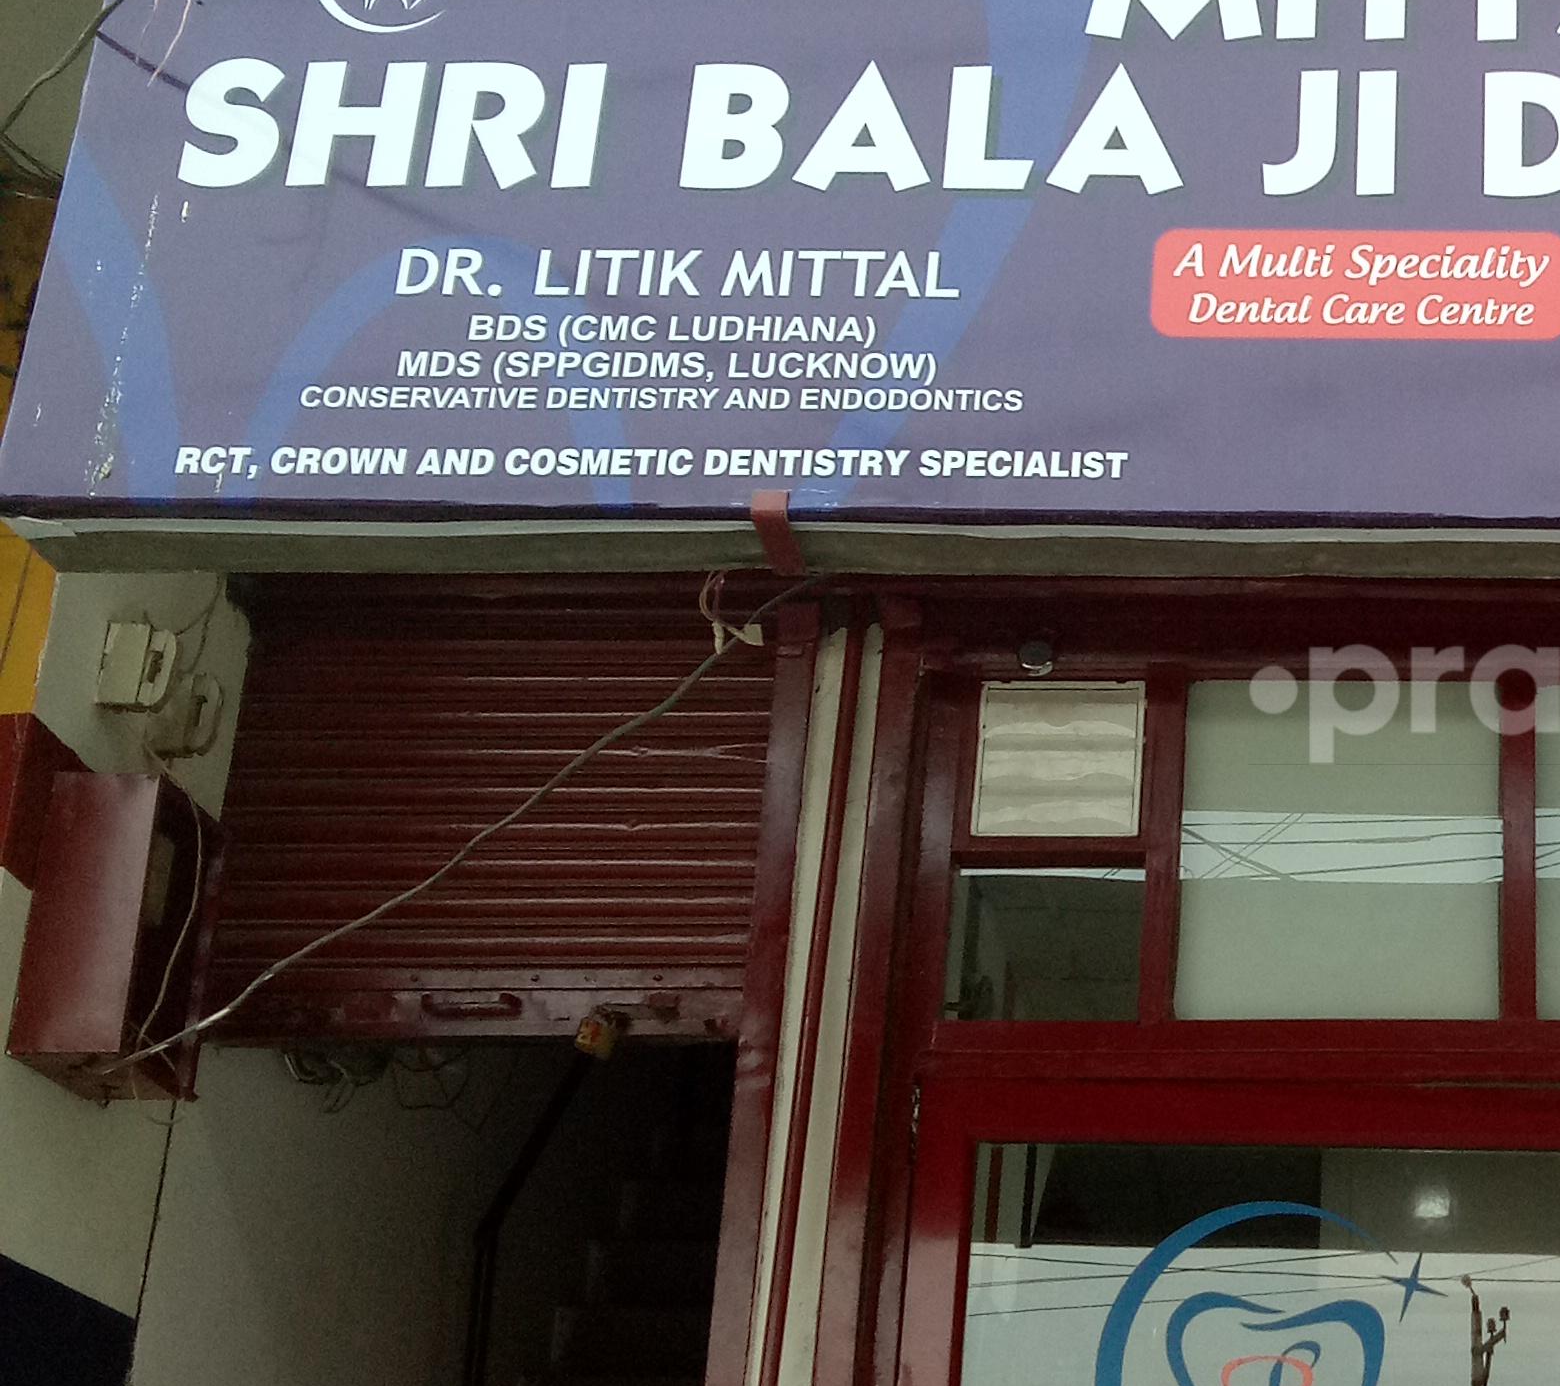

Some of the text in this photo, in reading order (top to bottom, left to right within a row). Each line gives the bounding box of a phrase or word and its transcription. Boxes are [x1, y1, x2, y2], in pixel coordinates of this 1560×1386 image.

[178, 58, 607, 189] SHRI
[680, 60, 1183, 194] BALA
[1263, 70, 1397, 195] JI
[396, 249, 959, 297] DR. LITIK MITTAL
[1173, 242, 1551, 288] A Multi Speciality
[1187, 292, 1535, 326] Dental Care Centre
[469, 315, 875, 348] BDS (CMC LUDHIANA)
[398, 351, 935, 385] MDS (SPPGIDMS, LUCKNOW)
[301, 386, 1022, 411] CONSERVATIVE DENTISTRY AND ENDODONTICS
[175, 447, 1128, 480] RCT, CROWN AND COSMETIC DENTISTRY SPECIALIST
